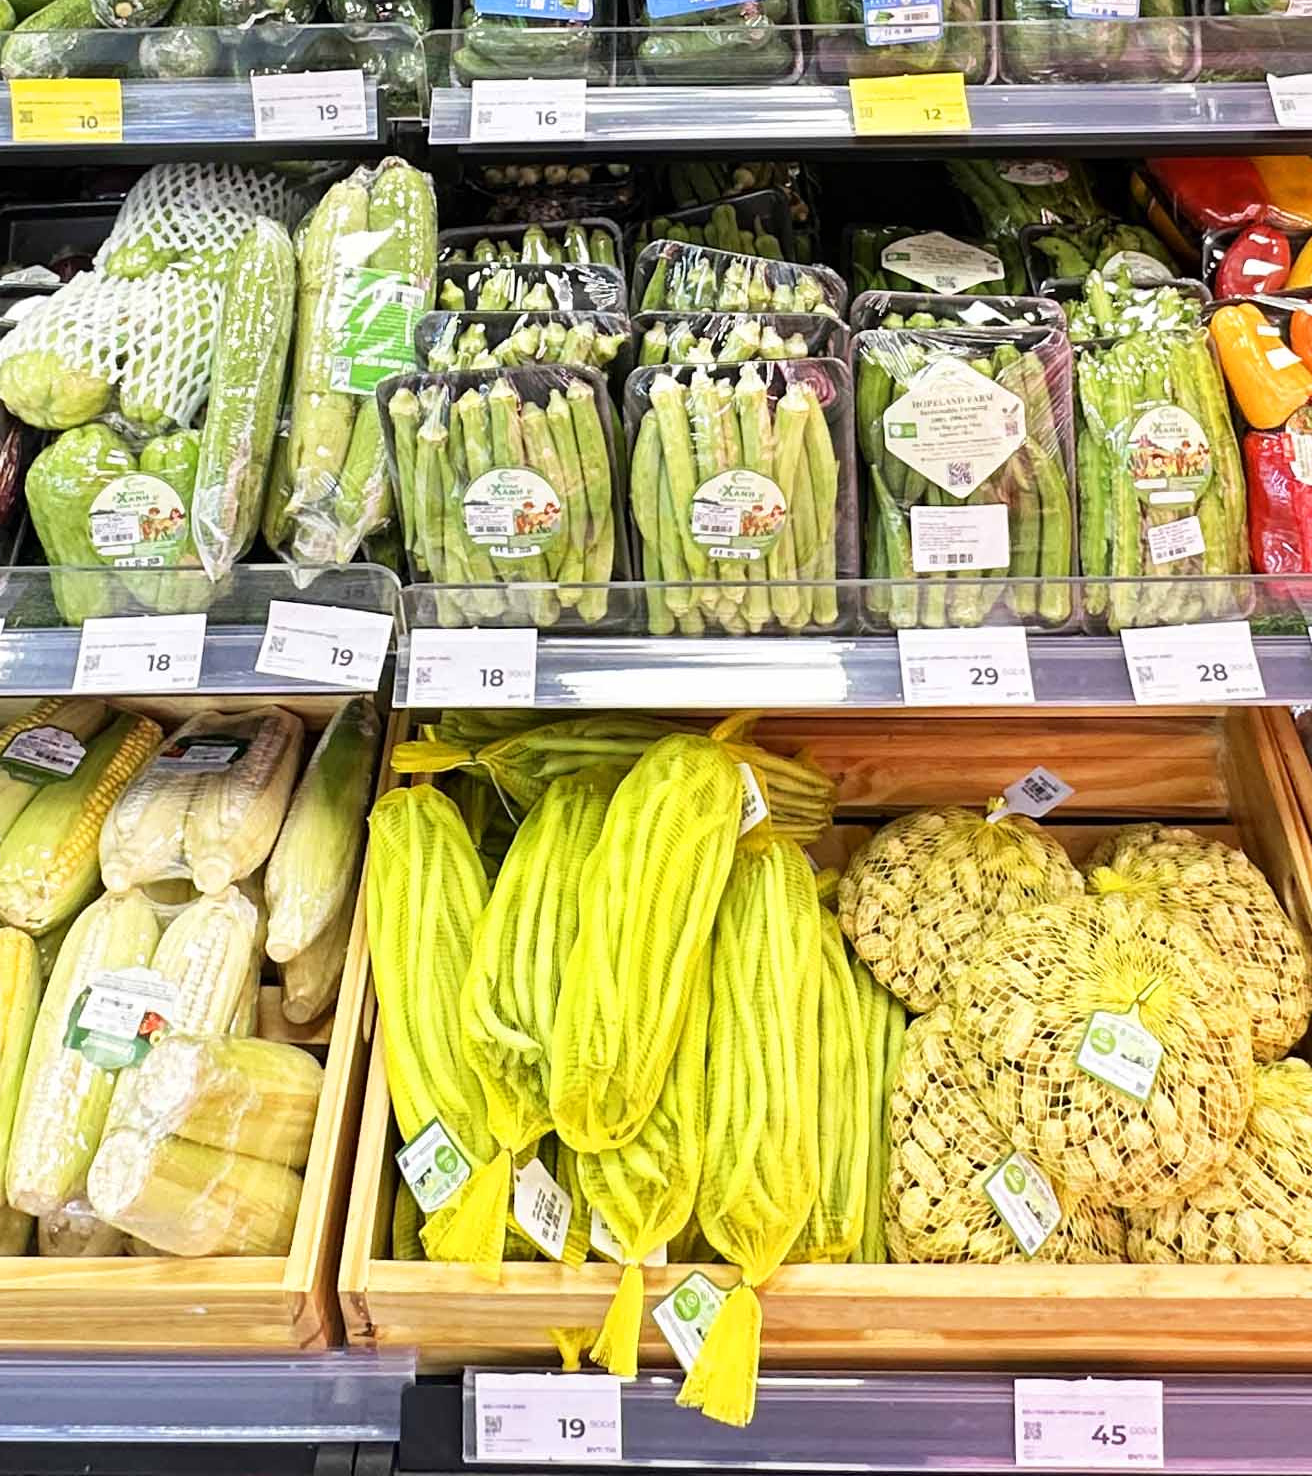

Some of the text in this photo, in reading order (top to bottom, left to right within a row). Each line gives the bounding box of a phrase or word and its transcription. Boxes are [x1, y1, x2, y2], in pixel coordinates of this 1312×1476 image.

[317, 105, 341, 122] 19
[535, 110, 558, 126] 16
[923, 108, 942, 121] 12
[77, 115, 99, 130] 10
[967, 392, 993, 404] FARM
[117, 490, 150, 504] XANH
[490, 483, 524, 497] XANH
[722, 484, 757, 497] XANH
[147, 653, 171, 672] 18
[331, 647, 354, 667] 19
[479, 668, 504, 688] 18
[969, 667, 999, 686] 29
[1196, 663, 1229, 682] 28
[557, 1418, 586, 1439] 19
[1091, 1424, 1127, 1446] 45
